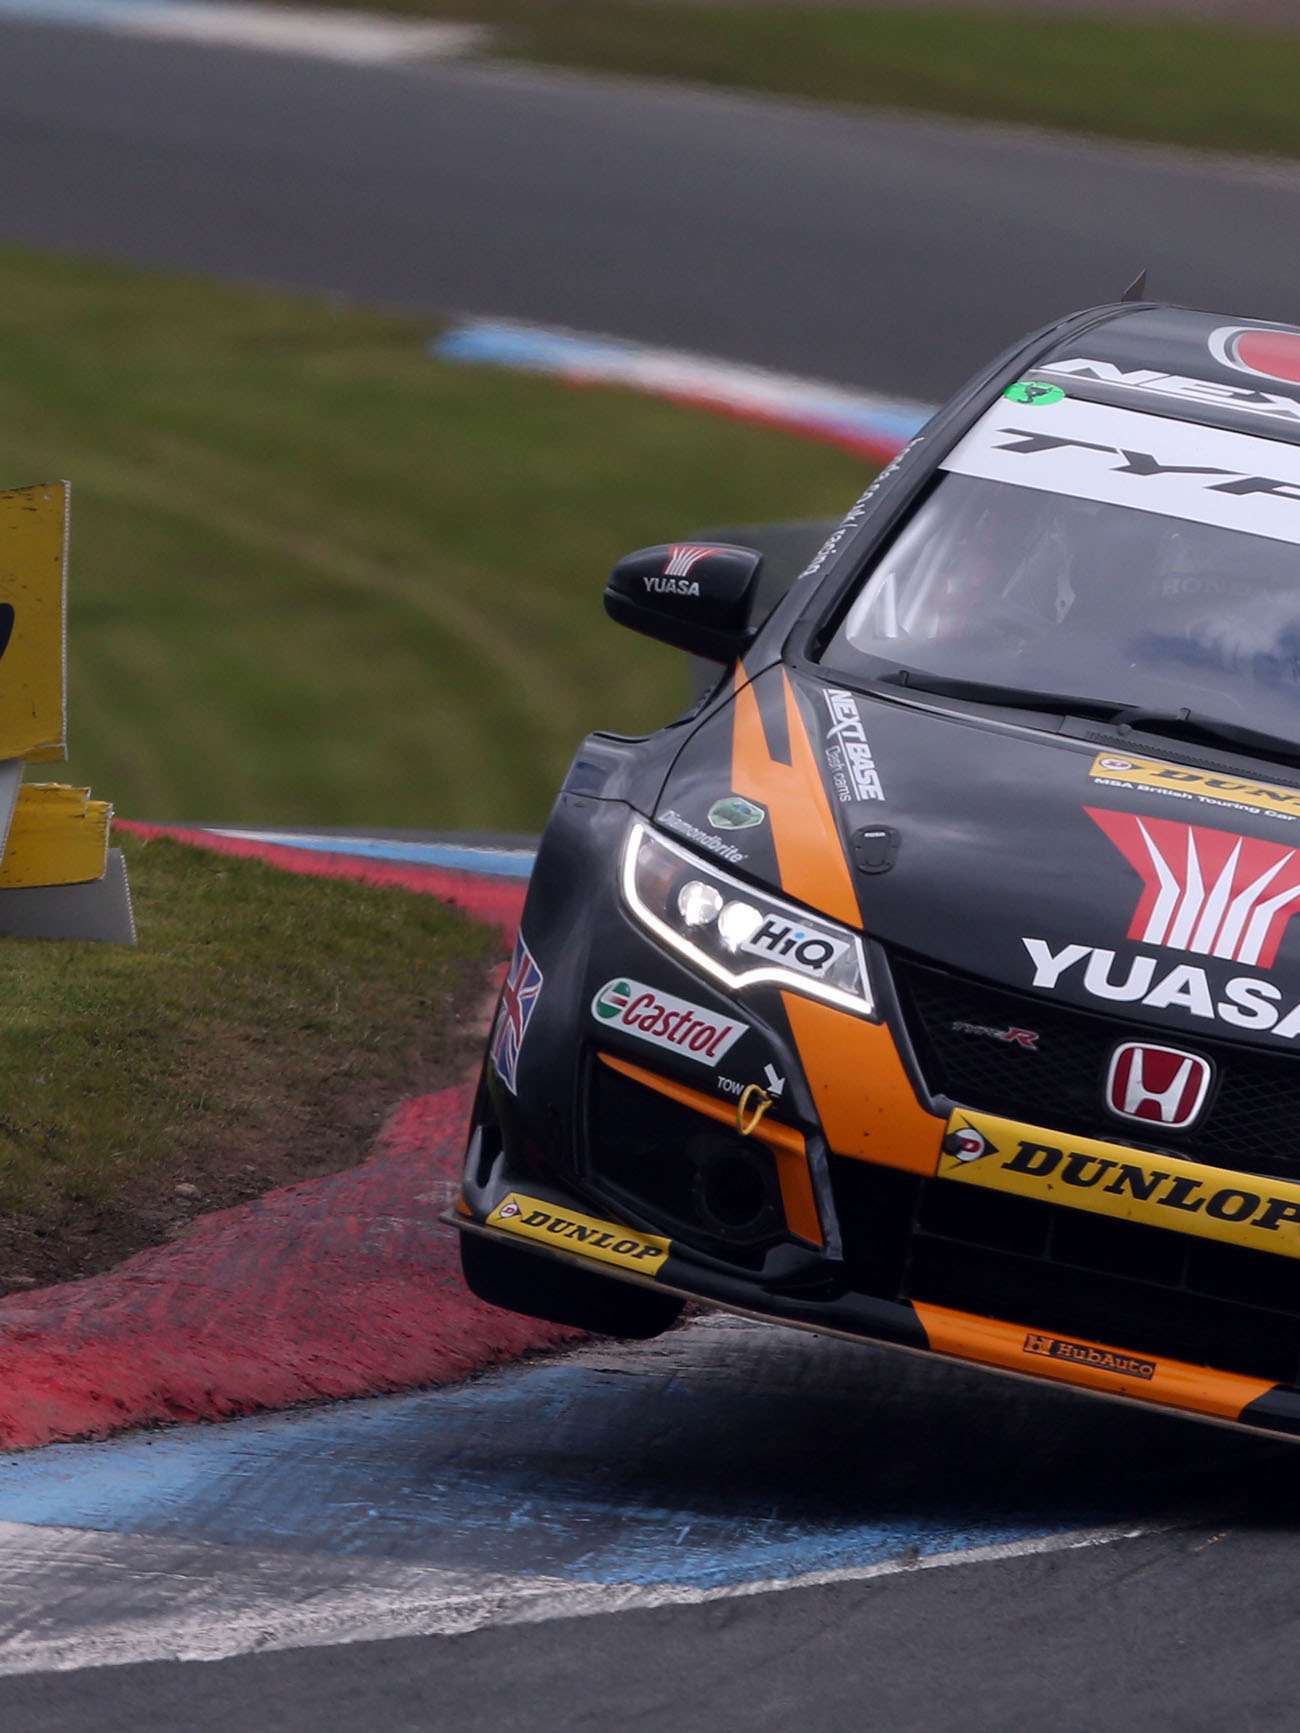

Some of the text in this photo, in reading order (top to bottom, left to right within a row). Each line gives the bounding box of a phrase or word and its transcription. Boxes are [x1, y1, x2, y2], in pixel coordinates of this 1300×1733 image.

[643, 576, 700, 596] YUASA
[833, 772, 852, 802] cams
[1094, 777, 1134, 790] MSA
[1137, 784, 1193, 800] British
[1197, 795, 1261, 815] Touring
[1264, 809, 1297, 822] Car
[658, 809, 743, 863] Diamondbrite
[750, 920, 834, 973] HiQ
[623, 991, 734, 1059] Castrol
[717, 1075, 745, 1096] TOW
[520, 1210, 664, 1260] DUNLOP
[1059, 1343, 1154, 1376] HubAuto
